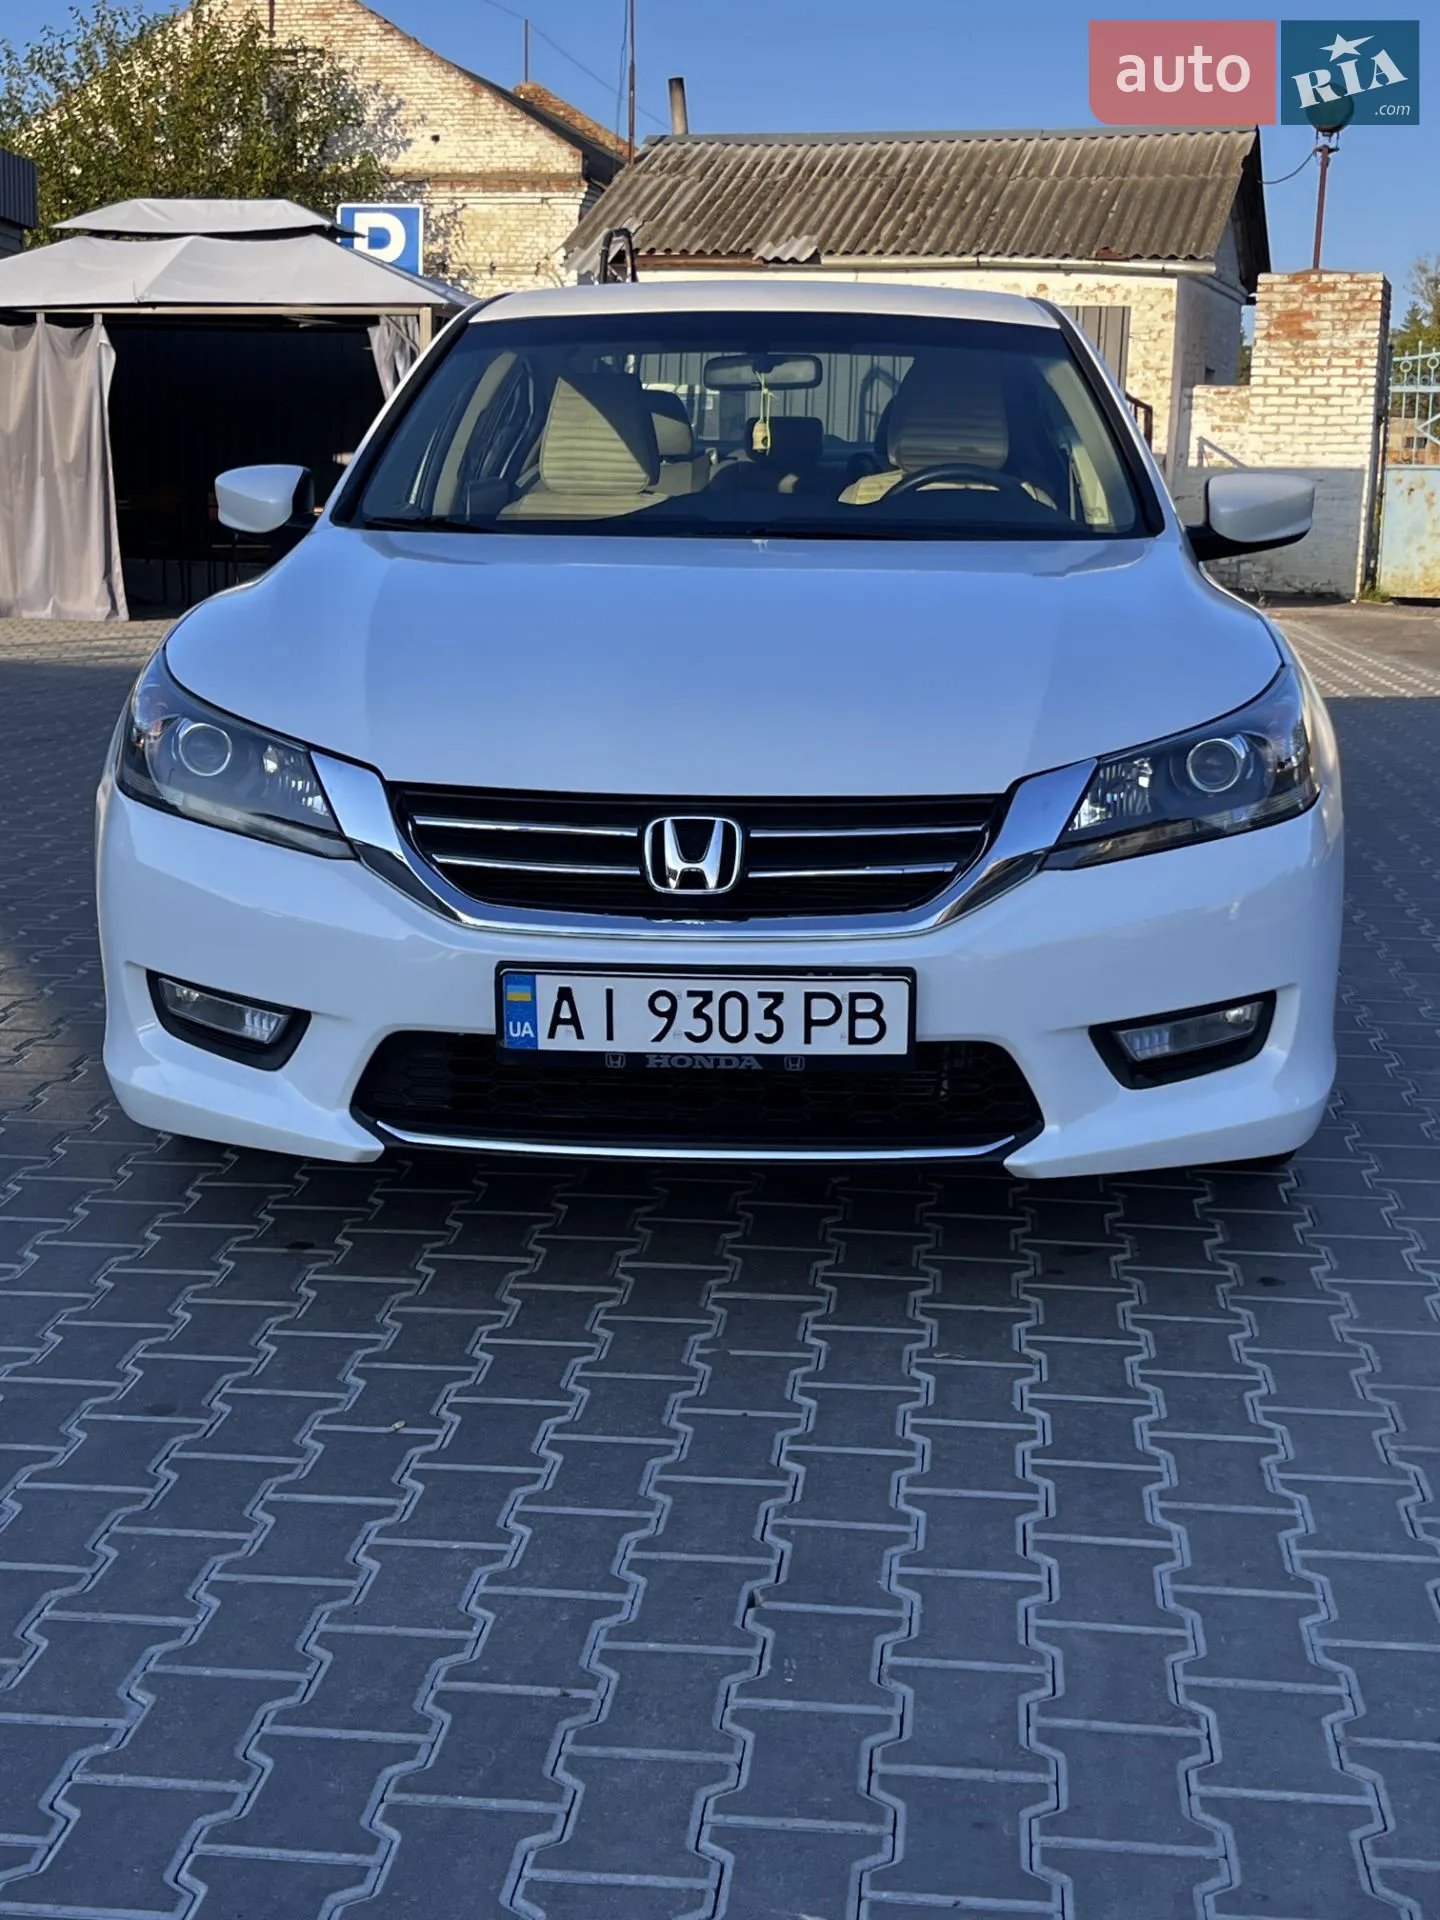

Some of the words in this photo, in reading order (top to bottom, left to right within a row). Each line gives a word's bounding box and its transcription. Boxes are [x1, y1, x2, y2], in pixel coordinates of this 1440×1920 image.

[648, 990, 785, 1044] 9303
[803, 991, 888, 1046] PB
[509, 1021, 535, 1038] UA
[646, 1054, 763, 1069] HONDA
